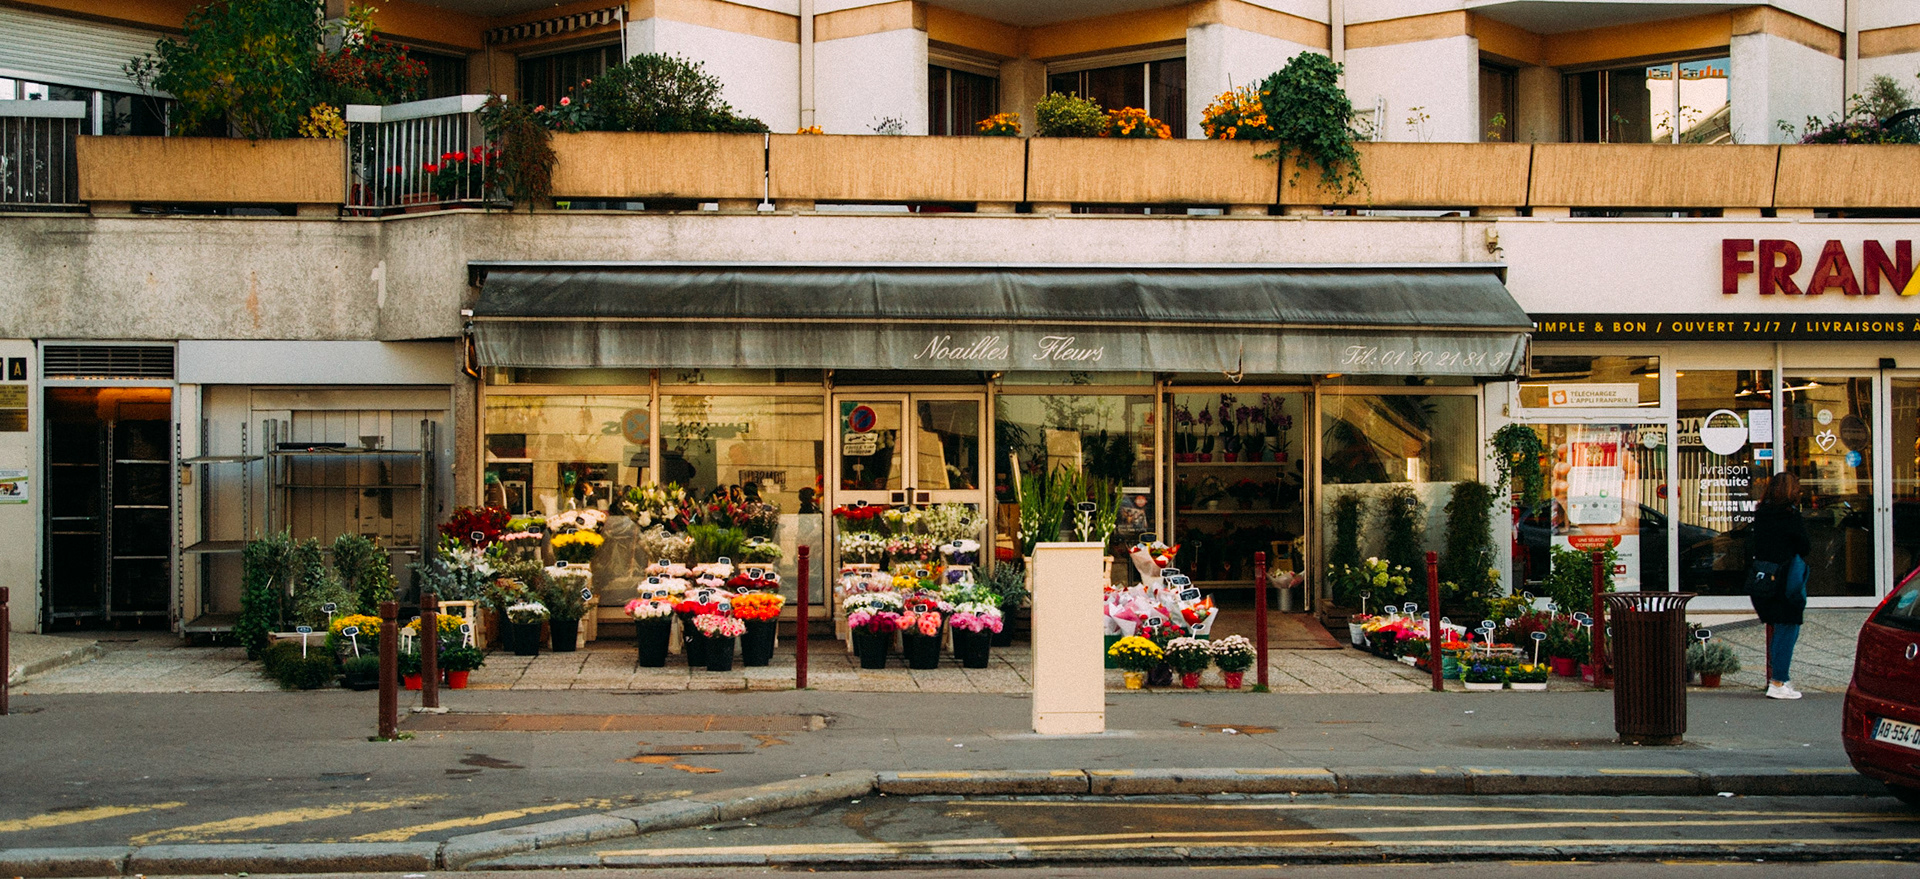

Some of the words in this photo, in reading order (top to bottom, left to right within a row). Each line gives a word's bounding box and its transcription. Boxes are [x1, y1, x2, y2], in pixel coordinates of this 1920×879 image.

[1538, 321, 1586, 333] IMPLE
[1594, 321, 1604, 333] &
[1613, 321, 1647, 333] BON
[1656, 321, 1663, 333] /
[1672, 321, 1735, 333] OUVERT
[1743, 321, 1782, 333] 7J/7
[1790, 321, 1797, 333] /
[1806, 321, 1905, 333] LIVRAISONS
[913, 335, 1010, 361] Noailles
[1032, 335, 1104, 361] Fleurs
[1380, 350, 1404, 366] 01
[1407, 350, 1434, 366] 30
[1435, 350, 1462, 367] 21
[1462, 350, 1486, 366] 81
[1489, 351, 1513, 366] 37
[13, 361, 22, 376] A
[1700, 462, 1749, 475] livraison
[1701, 514, 1733, 522] Transfert
[1733, 515, 1755, 523] d'arge
[1877, 721, 1920, 745] AB-554-Q
